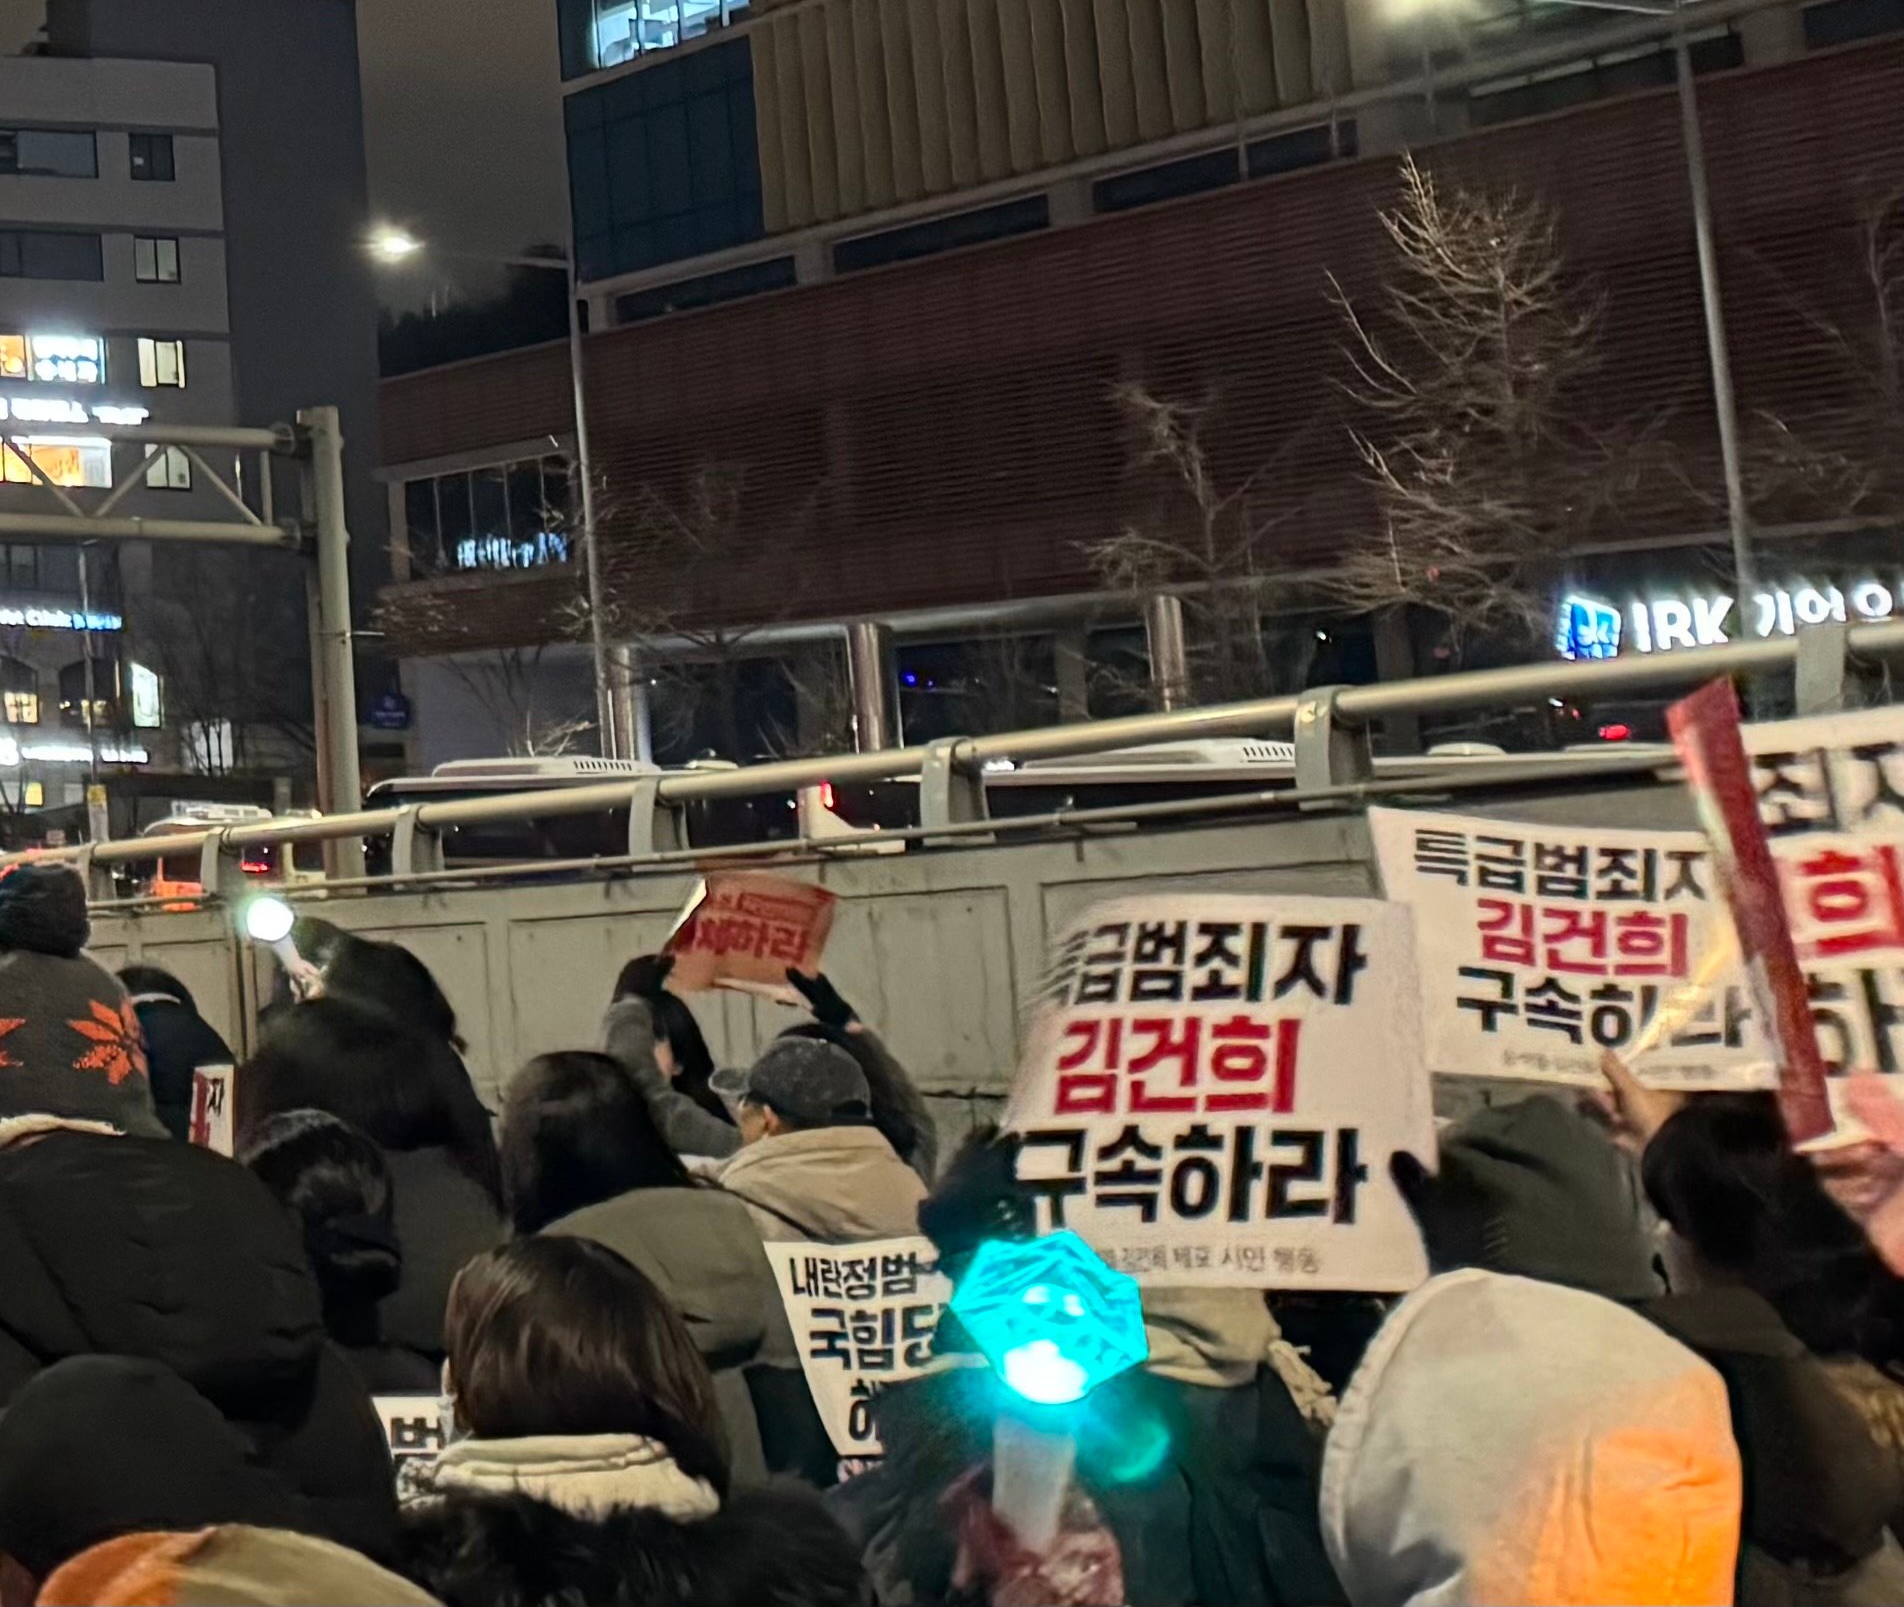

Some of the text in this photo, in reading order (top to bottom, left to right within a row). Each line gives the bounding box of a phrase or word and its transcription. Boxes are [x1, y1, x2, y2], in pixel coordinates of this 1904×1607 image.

[1477, 898, 1689, 979] 김건희
[1054, 1015, 1302, 1115] 김건희
[1017, 1124, 1369, 1225] 구속하라
[790, 1251, 918, 1301] 내란정범
[809, 1302, 947, 1371] 국힘당
